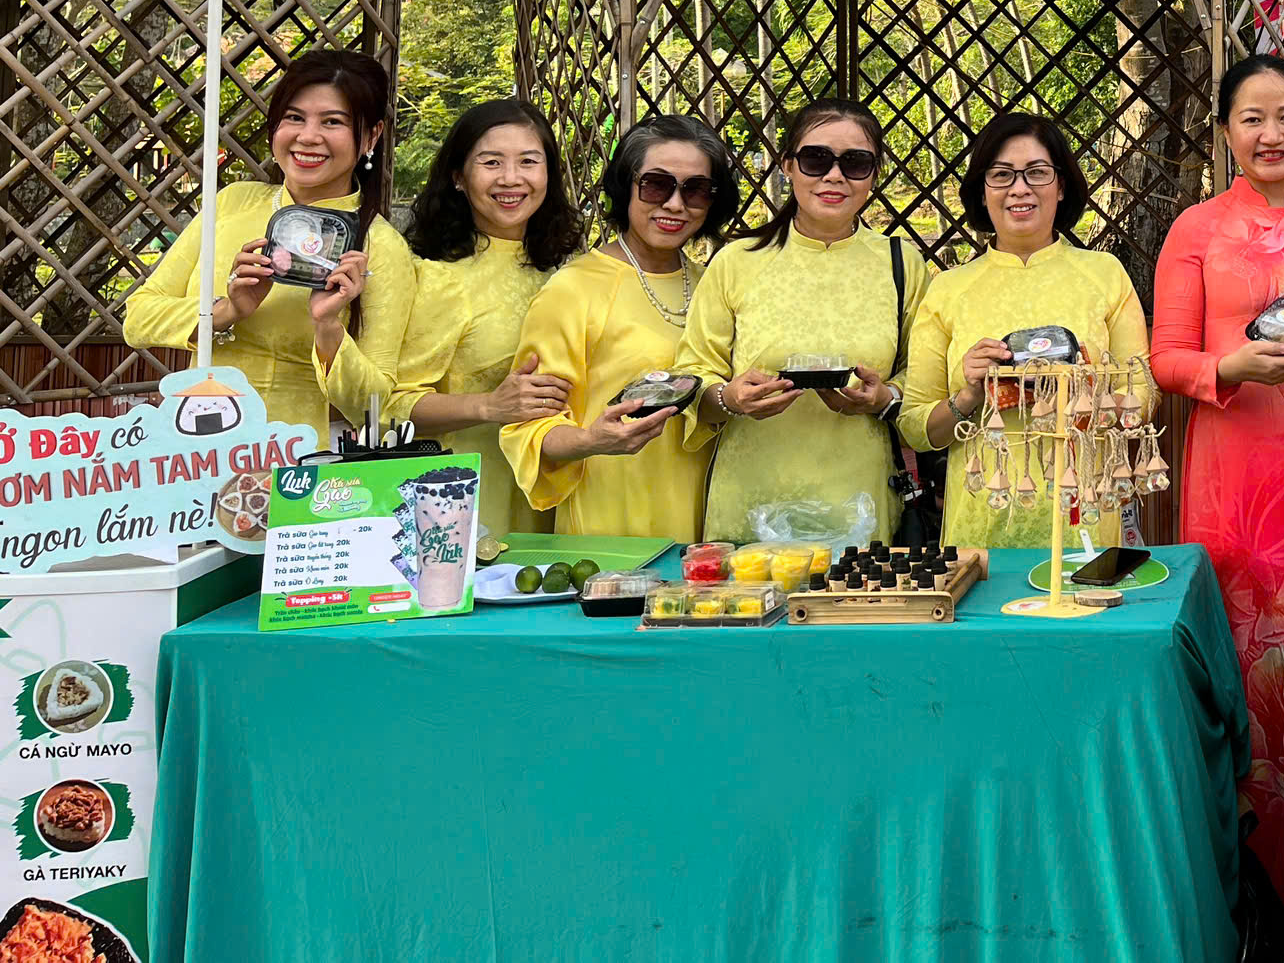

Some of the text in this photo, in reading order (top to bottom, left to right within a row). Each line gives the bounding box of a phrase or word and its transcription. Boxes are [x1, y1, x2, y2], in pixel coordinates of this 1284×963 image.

[29, 425, 100, 460] Đây
[110, 417, 149, 449] có
[63, 451, 140, 499] NẮM
[150, 449, 219, 485] TAM
[228, 433, 303, 474] GIÁC
[1, 493, 217, 569] ngon lắm nè!
[290, 595, 326, 605] Topping
[19, 743, 132, 759] CÁ NGỪ MAYO
[23, 865, 127, 883] GÀ TERIYAKY
